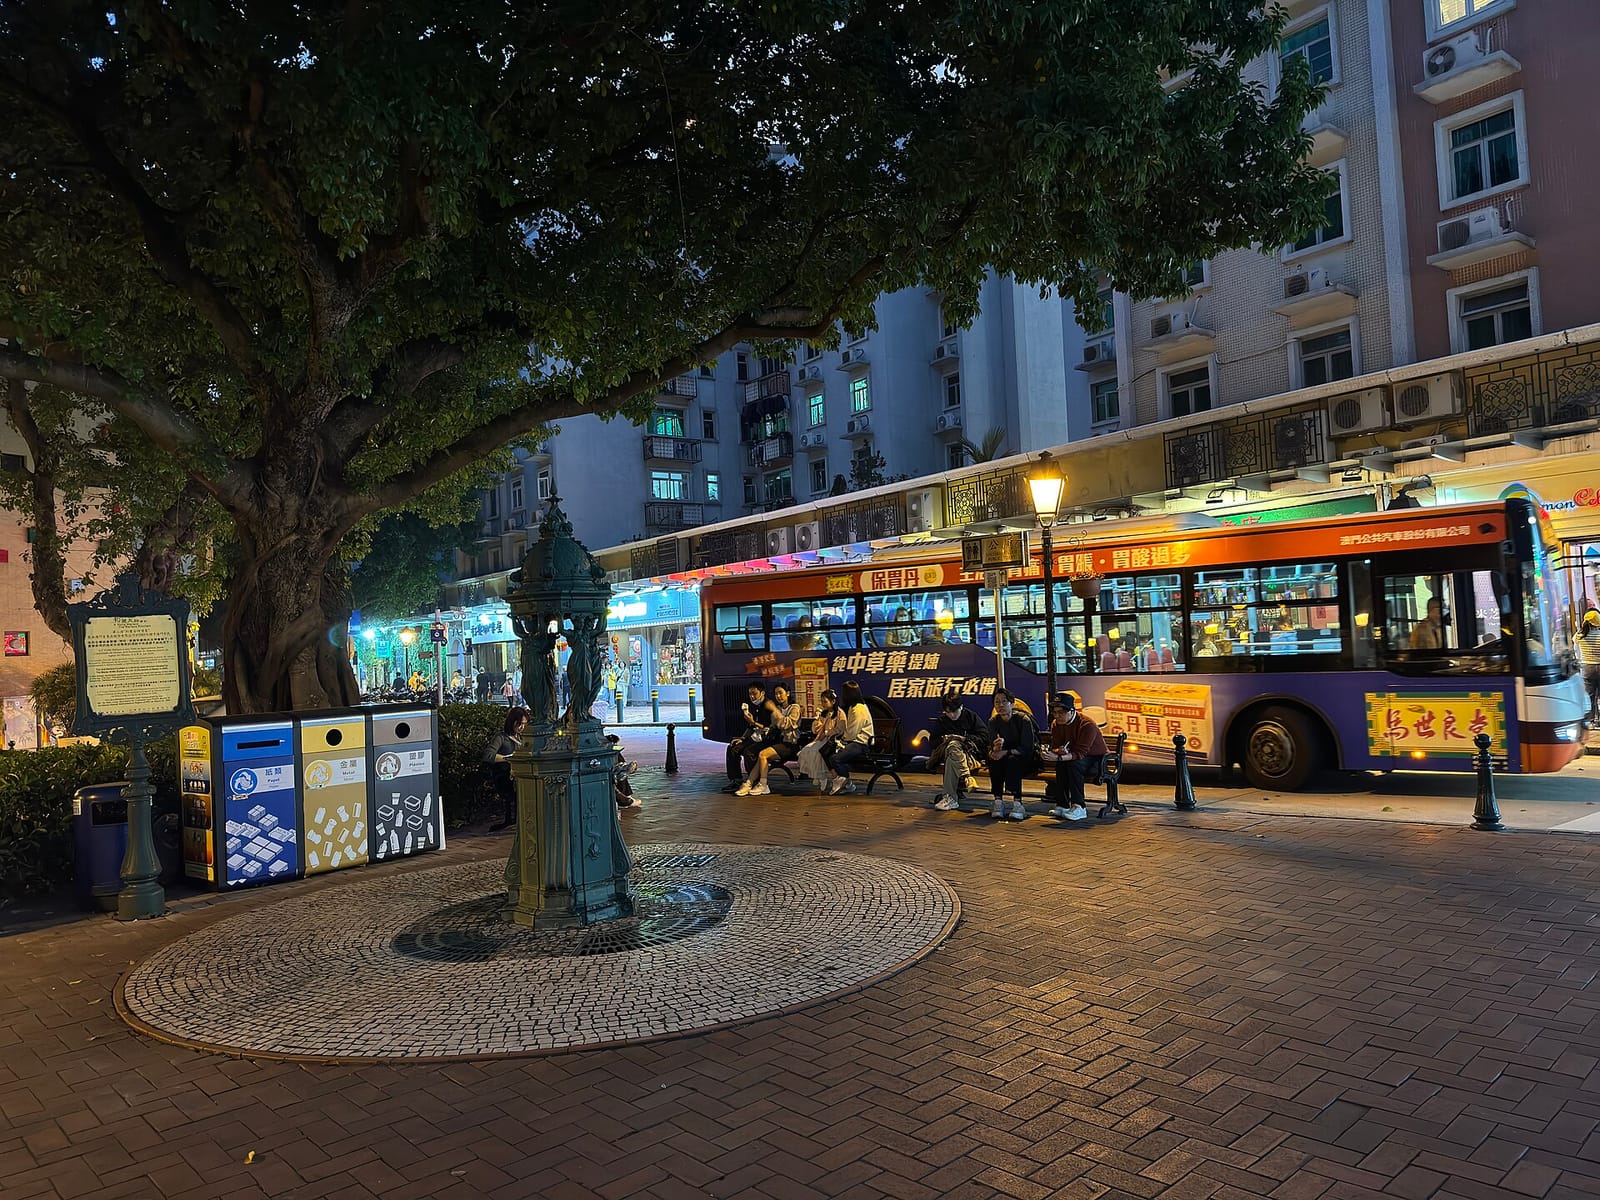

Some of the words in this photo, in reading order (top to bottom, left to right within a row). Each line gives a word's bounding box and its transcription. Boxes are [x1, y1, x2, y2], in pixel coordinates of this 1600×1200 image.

[872, 568, 920, 591] 保胃丹
[831, 651, 941, 675] 純中草藥提煉
[887, 676, 998, 699] 居家旅行必備
